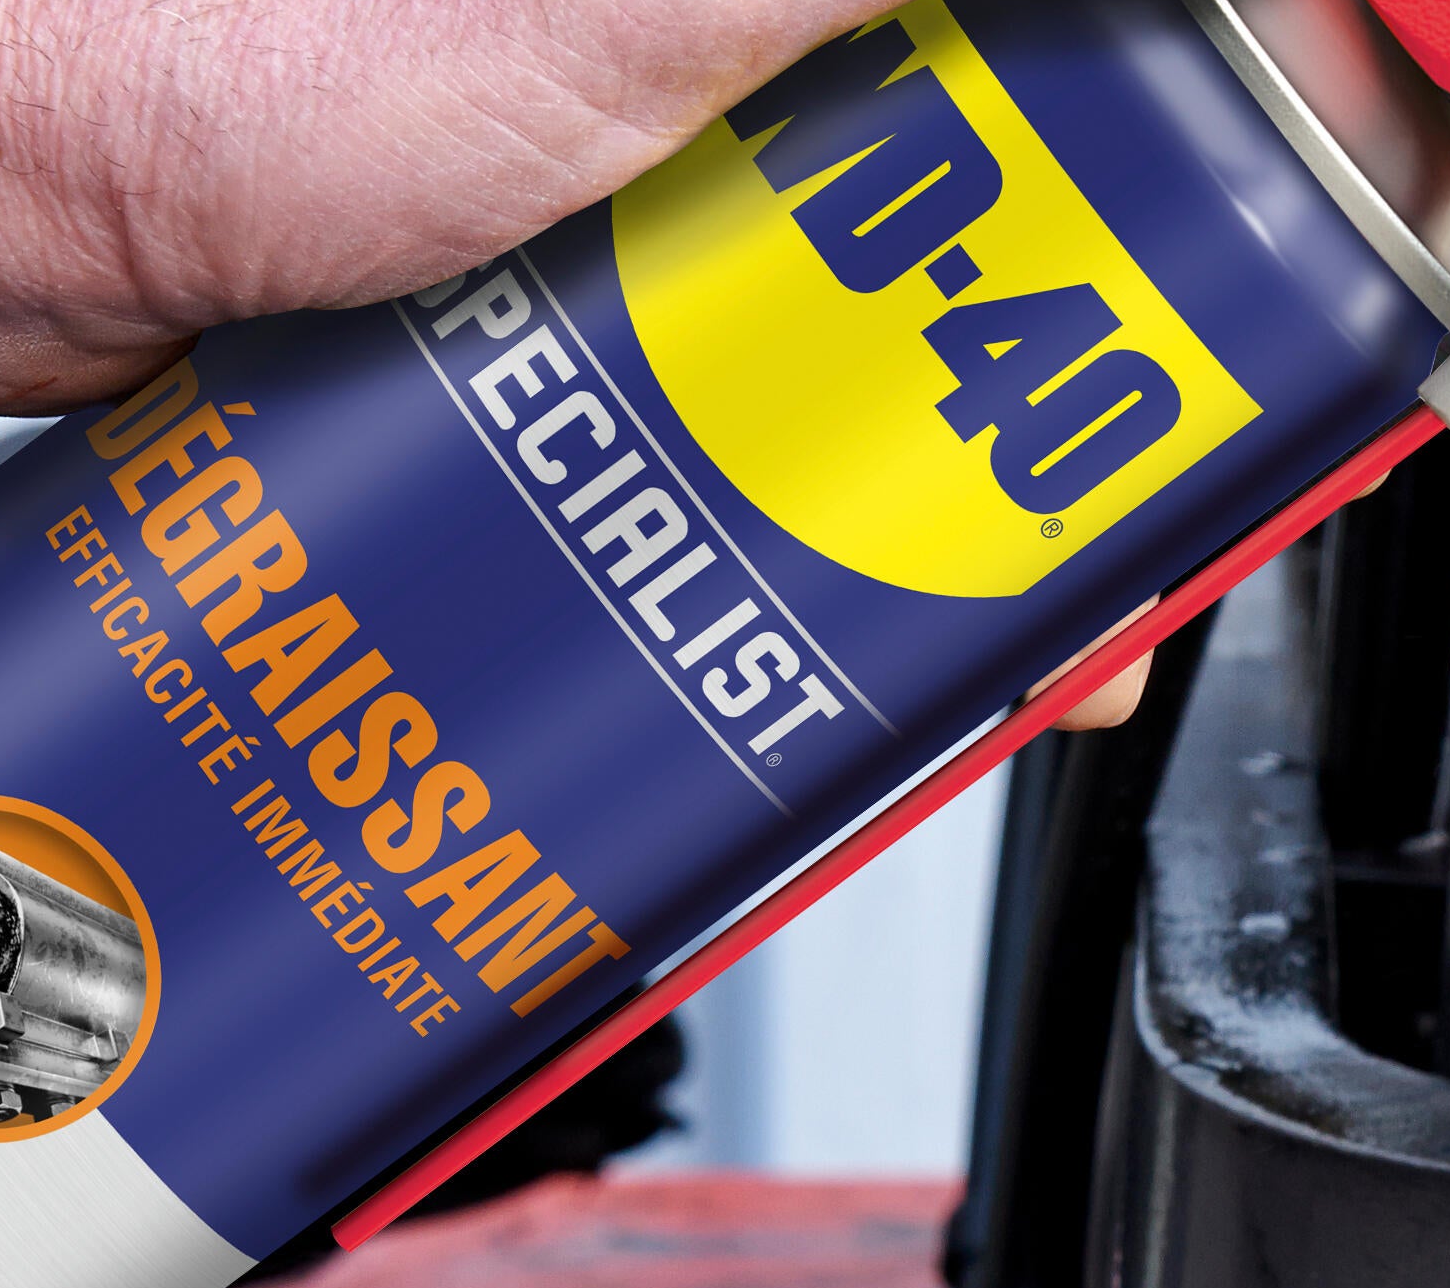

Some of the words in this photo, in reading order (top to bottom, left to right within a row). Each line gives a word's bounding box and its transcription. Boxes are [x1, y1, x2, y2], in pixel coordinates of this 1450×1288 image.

[723, 17, 1182, 515] WD-40
[44, 504, 262, 785] EFFICACITÉ
[230, 778, 462, 1038] IMMÉDIATE
[84, 357, 632, 1019] DÉGRAISSANT
